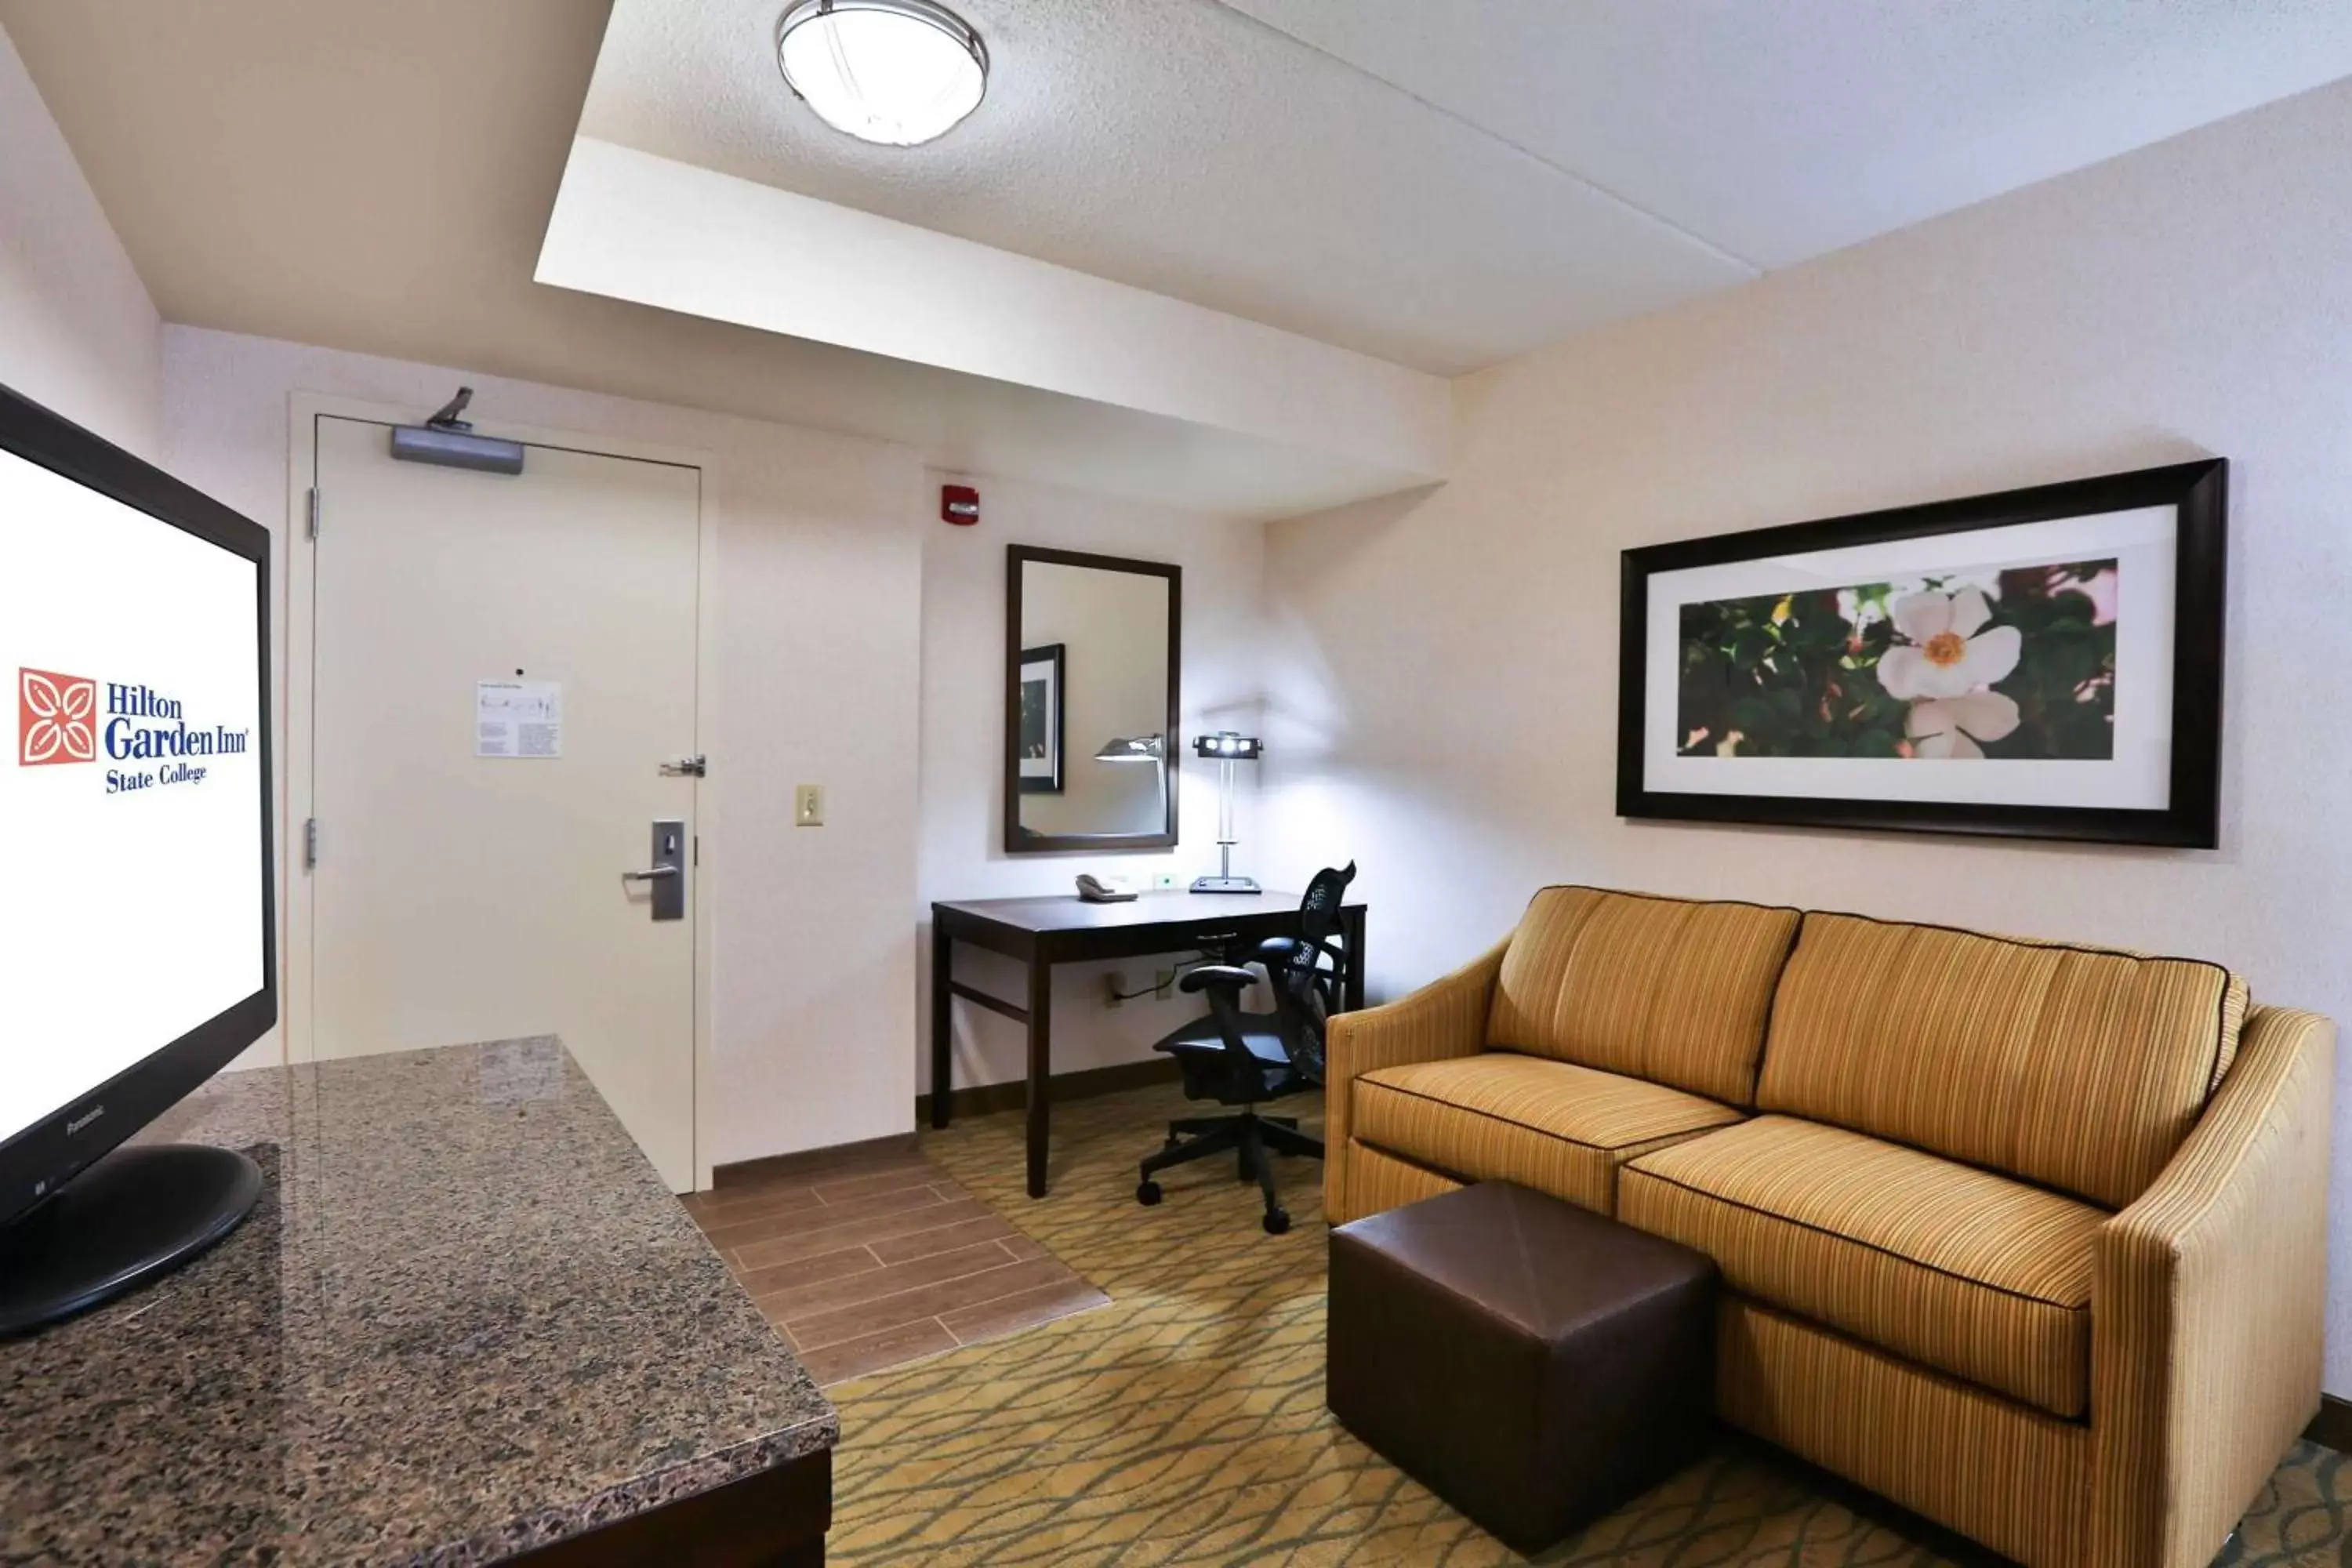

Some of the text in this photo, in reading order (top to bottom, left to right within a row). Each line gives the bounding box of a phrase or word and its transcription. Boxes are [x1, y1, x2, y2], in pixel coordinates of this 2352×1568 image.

[107, 683, 182, 719] Hilton
[105, 717, 246, 760] Garden Inn
[106, 763, 207, 794] State College
